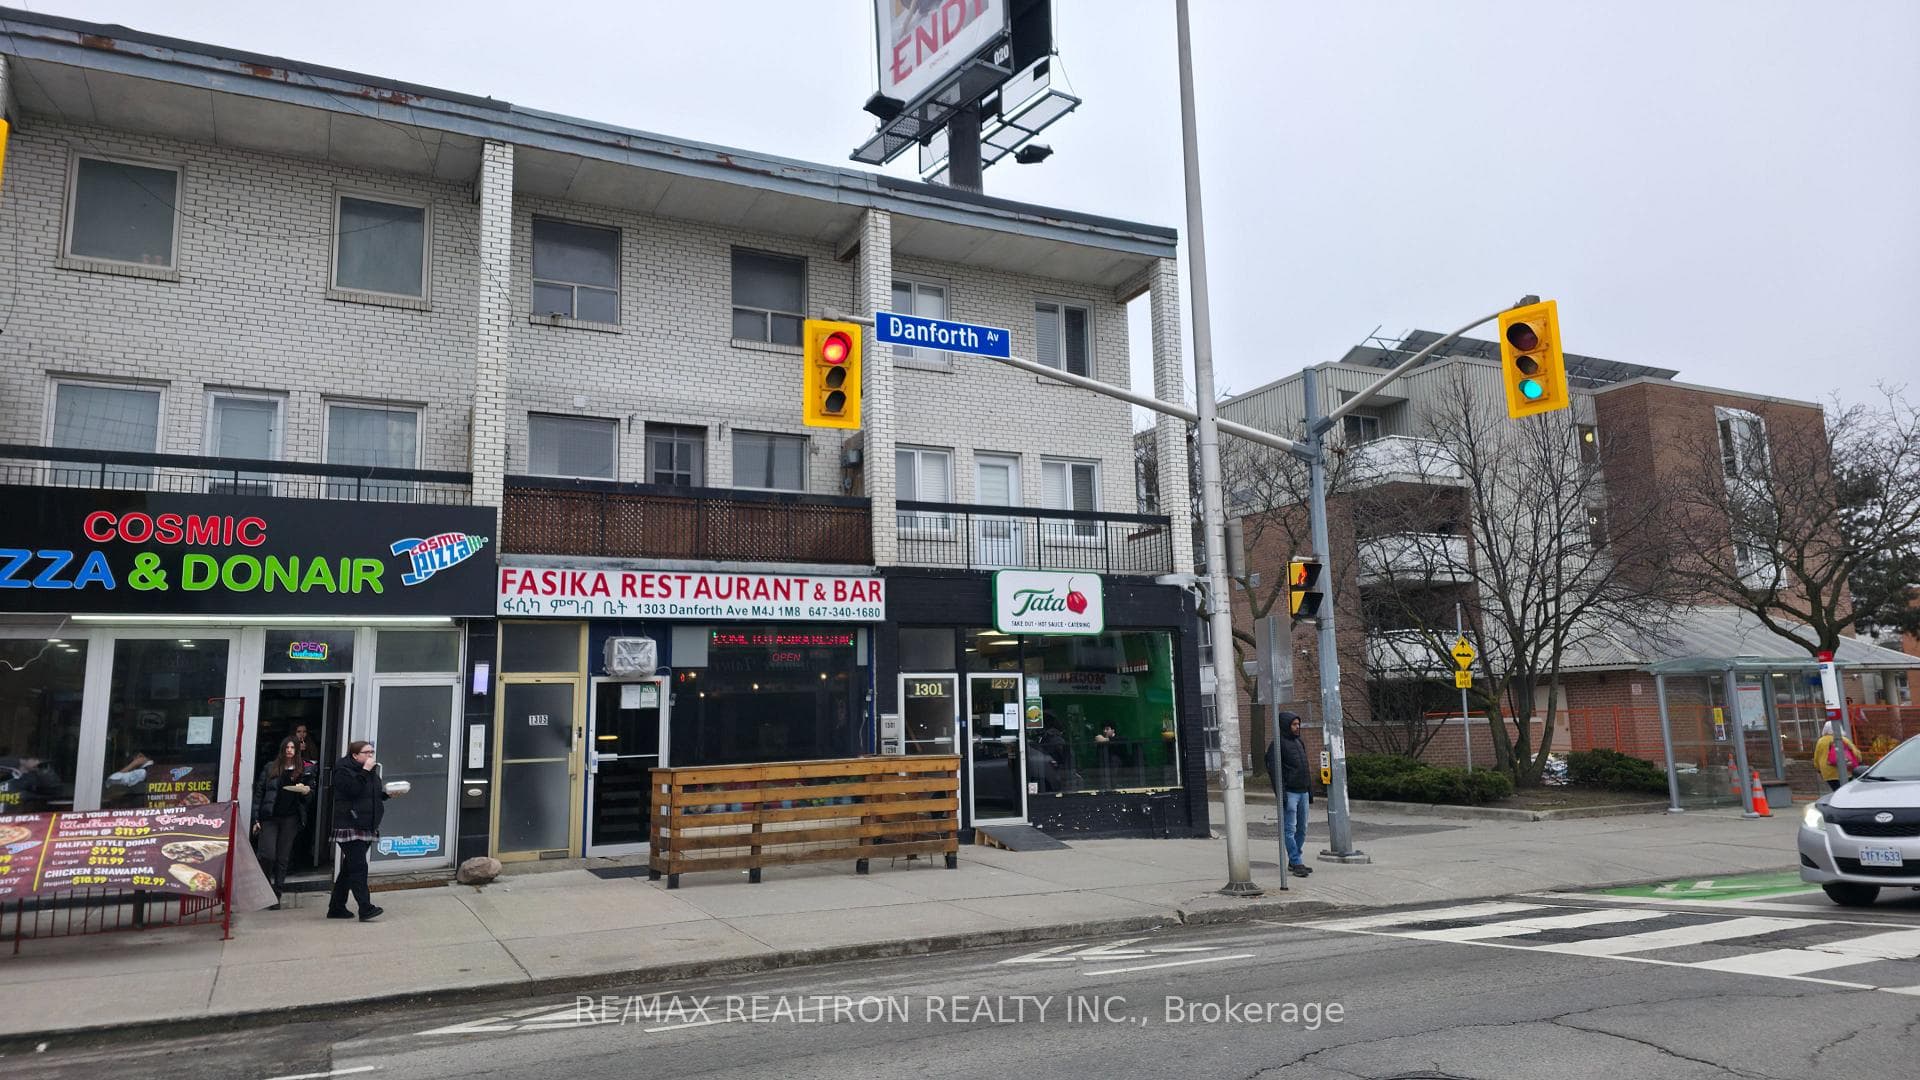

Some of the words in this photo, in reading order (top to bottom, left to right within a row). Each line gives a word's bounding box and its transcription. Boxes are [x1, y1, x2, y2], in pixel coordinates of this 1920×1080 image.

[994, 45, 1009, 65] 020
[889, 316, 979, 348] Danforth
[986, 331, 999, 341] Av
[83, 511, 267, 547] COSMIC
[128, 552, 169, 591] &
[181, 553, 385, 594] DONAIR
[500, 568, 611, 597] FASIKA
[621, 573, 809, 602] RESTAURANT
[813, 582, 827, 601] &
[833, 579, 882, 603] BAR
[550, 599, 593, 614] ምግብ
[603, 600, 627, 615] ቤት
[1012, 588, 1067, 617] Tata
[637, 603, 666, 615] 1303
[669, 604, 723, 616] Danforth
[726, 605, 749, 617] Ave
[751, 605, 775, 617] M4J
[778, 606, 801, 617] 1M8
[808, 606, 881, 618] 647-340-1680
[293, 641, 326, 653] OPEN
[773, 653, 800, 662] OPEN
[914, 683, 943, 696] 1301
[991, 679, 1015, 689] 1299
[148, 782, 173, 793] PIZZA
[175, 783, 187, 792] BY
[188, 781, 212, 791] SLICE
[112, 809, 133, 817] OWN
[135, 808, 161, 816] PIZZA
[163, 806, 187, 814] WITH
[58, 829, 99, 837] Starting
[114, 826, 150, 836] $11.99
[55, 841, 94, 849] HALIFAX
[95, 839, 124, 847] STYLE
[91, 846, 126, 855] $9.99
[88, 856, 124, 865] $11.99
[45, 868, 91, 878] CHICKEN
[94, 866, 154, 876] SHAWARMA
